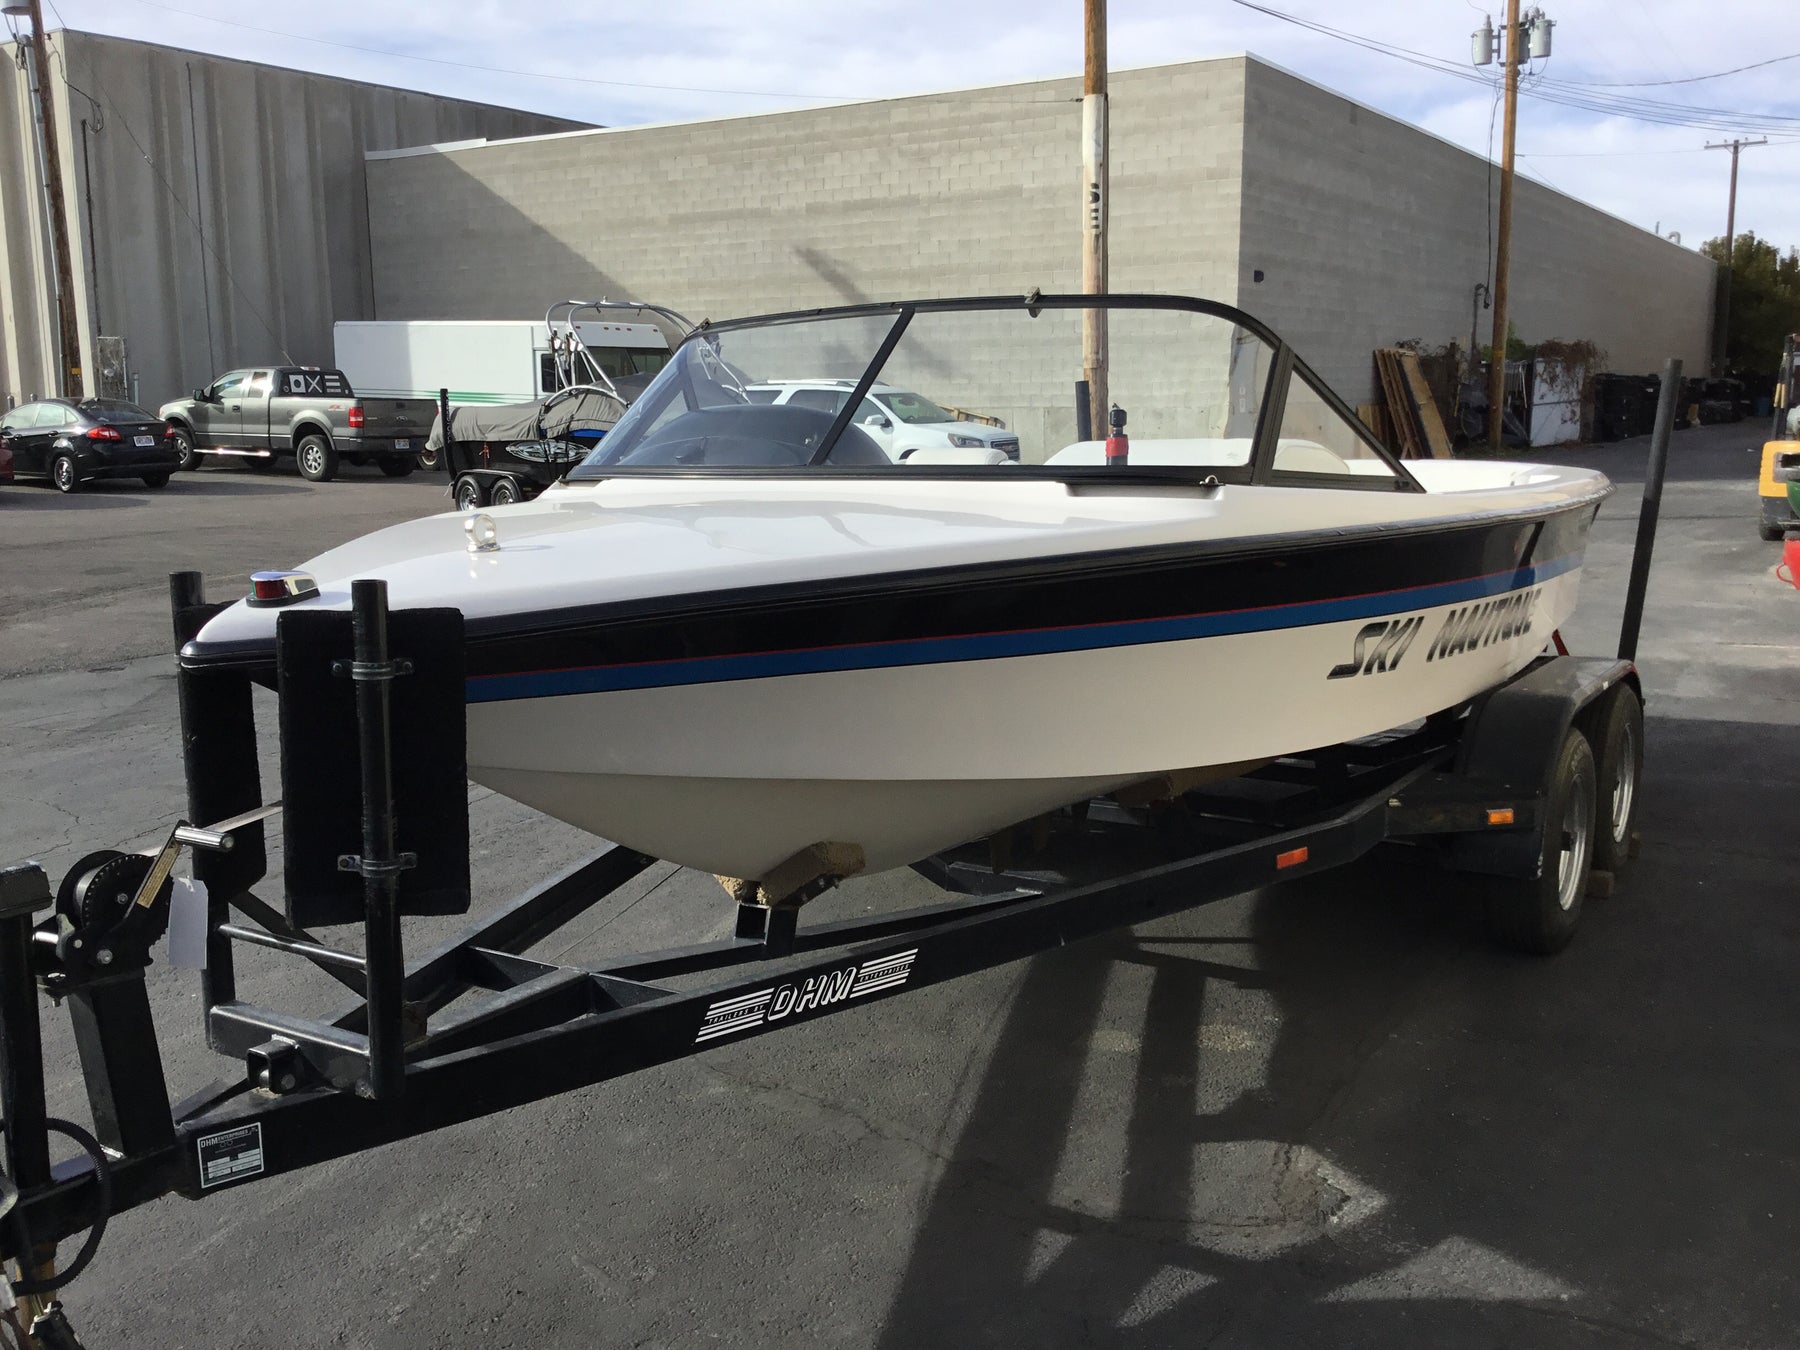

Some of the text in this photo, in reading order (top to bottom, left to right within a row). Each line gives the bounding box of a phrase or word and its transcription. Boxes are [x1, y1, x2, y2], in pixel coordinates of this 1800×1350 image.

[1326, 615, 1425, 680] SKI
[708, 1008, 749, 1025] TRAILERS
[753, 1004, 764, 1012] BY
[859, 963, 910, 983] ENTERPRISES
[200, 1137, 218, 1148] DHM
